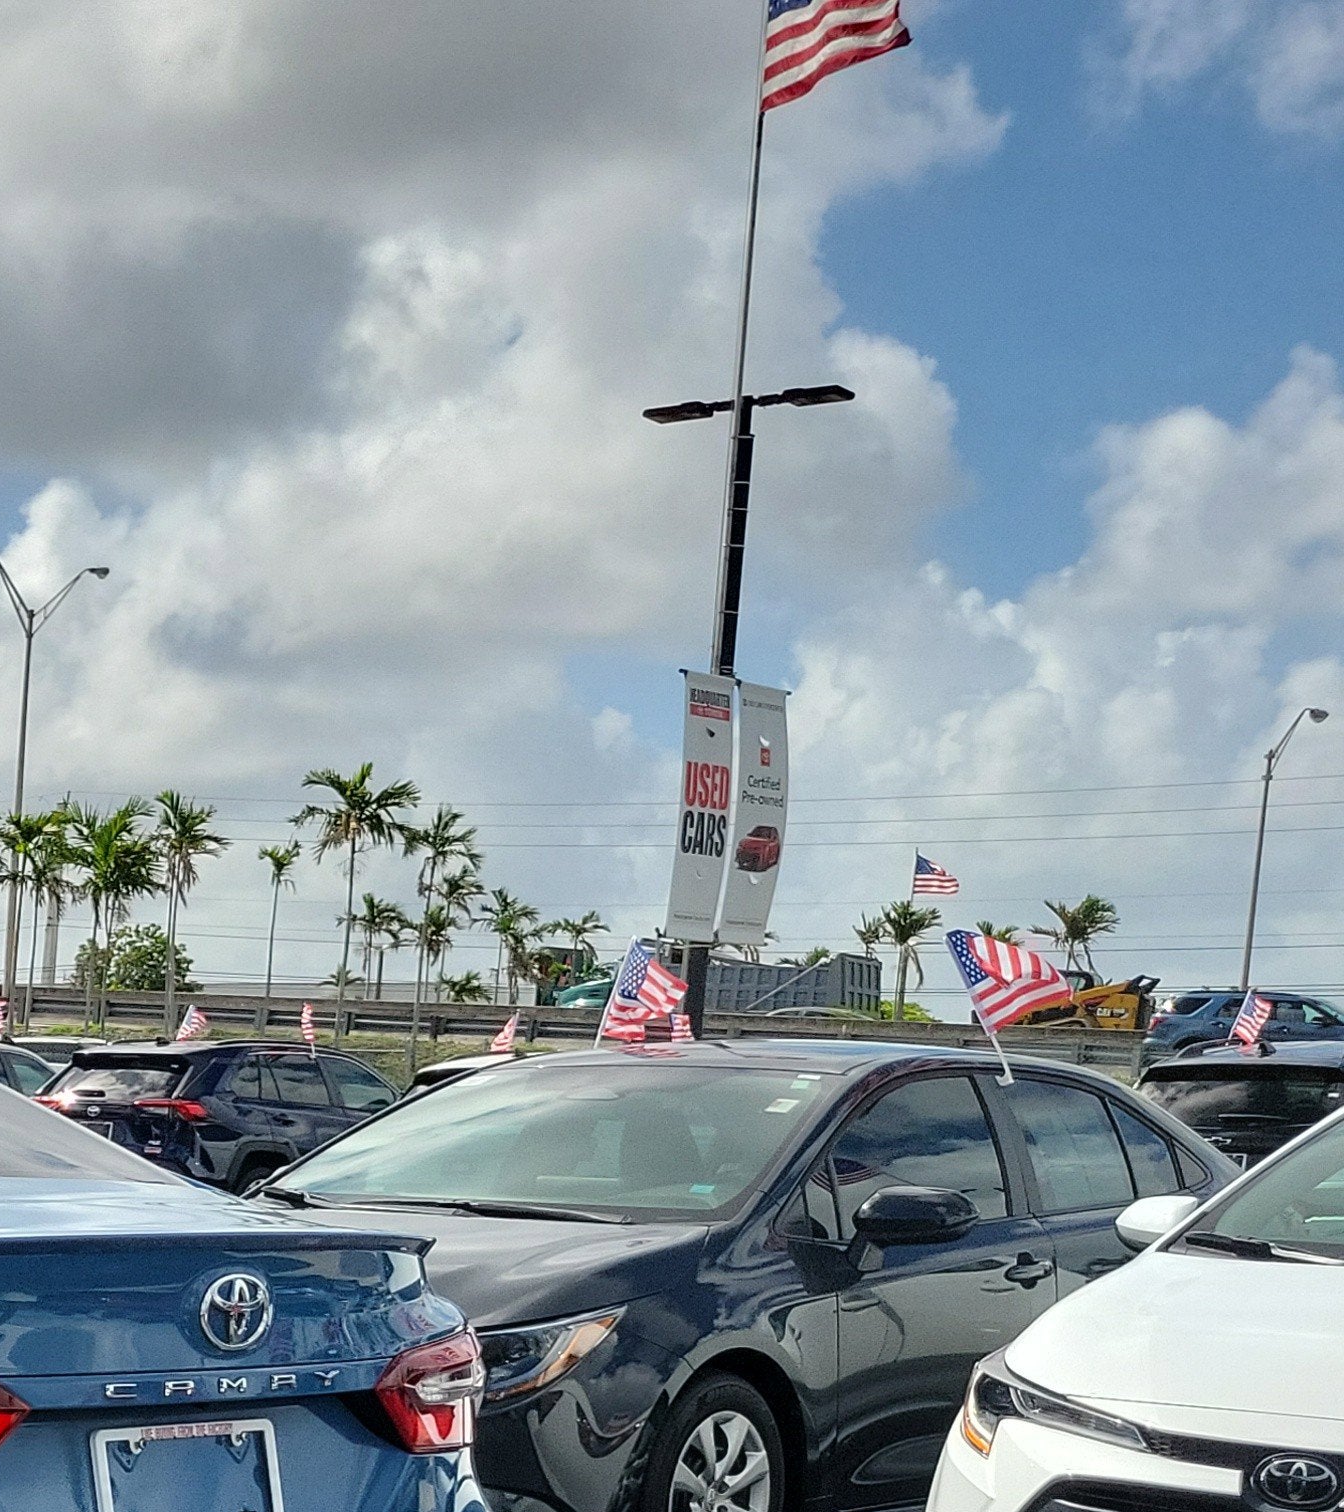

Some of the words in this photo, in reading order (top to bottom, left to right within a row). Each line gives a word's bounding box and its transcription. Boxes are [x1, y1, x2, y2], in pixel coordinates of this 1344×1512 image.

[685, 761, 730, 811] USED
[680, 810, 727, 858] CARS
[105, 1369, 341, 1399] CAMRY
